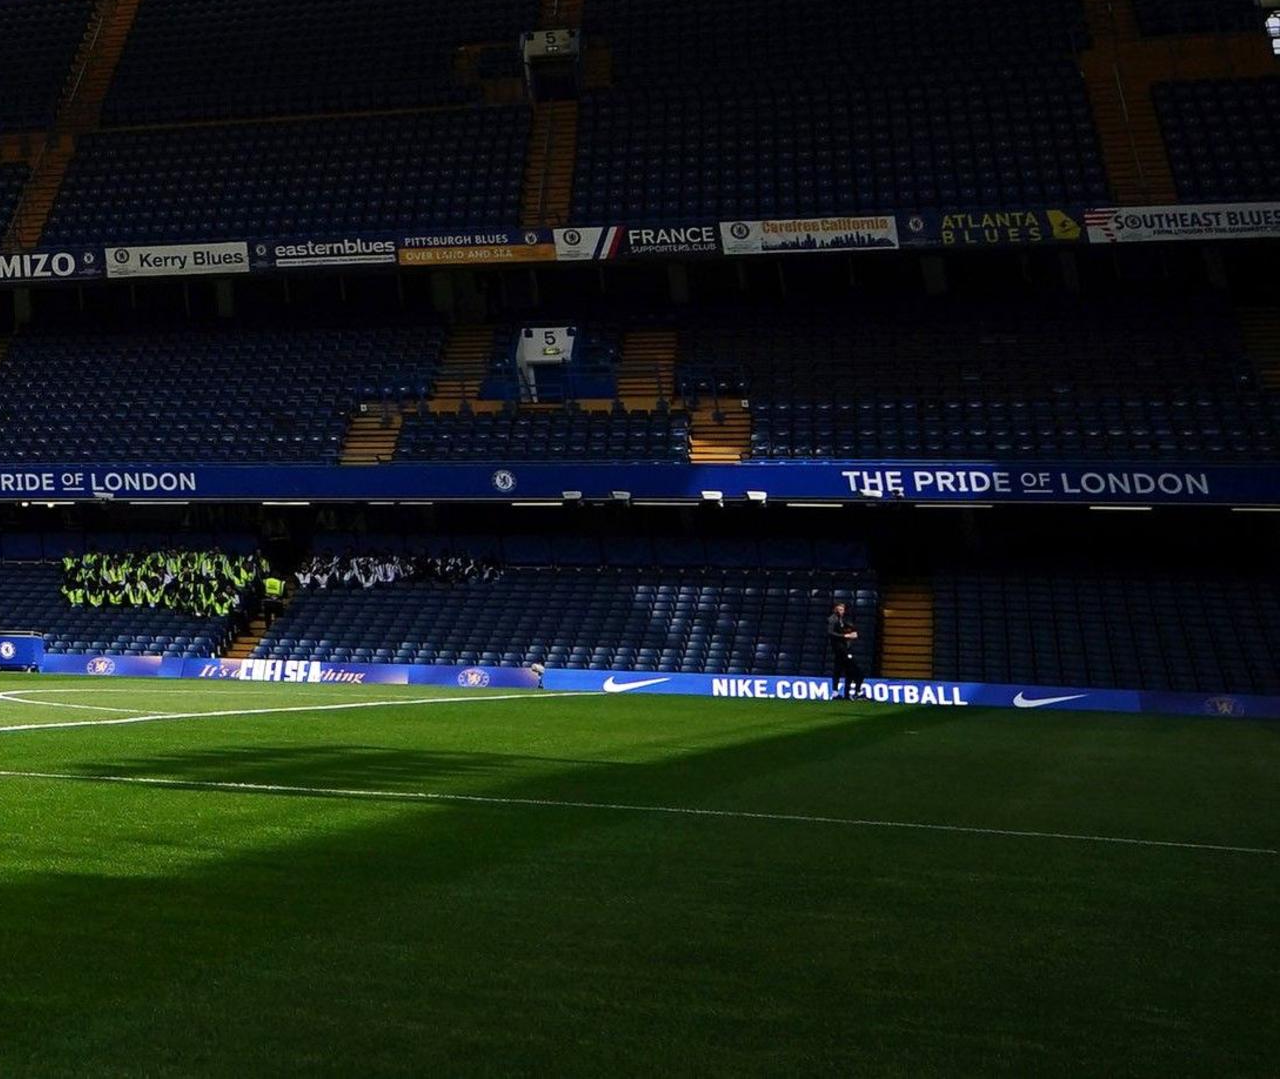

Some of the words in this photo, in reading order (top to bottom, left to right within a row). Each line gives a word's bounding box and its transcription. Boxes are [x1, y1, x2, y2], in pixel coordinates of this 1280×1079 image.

[546, 32, 556, 44] 5
[942, 211, 1040, 229] ATLANTA
[1227, 208, 1280, 224] BLUES
[762, 220, 820, 234] Carefree
[821, 218, 889, 232] California
[404, 234, 472, 246] PITTSBURGH
[474, 233, 509, 244] BLUES
[628, 226, 715, 246] FRANCE
[942, 227, 1042, 245] BLUES
[274, 237, 396, 257] easternblues
[406, 251, 432, 261] OVER
[436, 250, 464, 259] LAND
[467, 249, 490, 259] AND
[493, 248, 513, 258] SEA
[139, 252, 187, 269] Kerry
[193, 250, 244, 265] Blues
[545, 331, 556, 345] 5
[61, 473, 84, 488] OF
[90, 472, 196, 493] LONDON
[841, 470, 902, 493] THE
[913, 471, 1012, 493] PRIDE
[1020, 472, 1052, 490] OF
[1061, 472, 1210, 496] LONDON
[199, 664, 230, 678] It's
[239, 658, 321, 683] CHELSEA
[320, 667, 366, 684] thing
